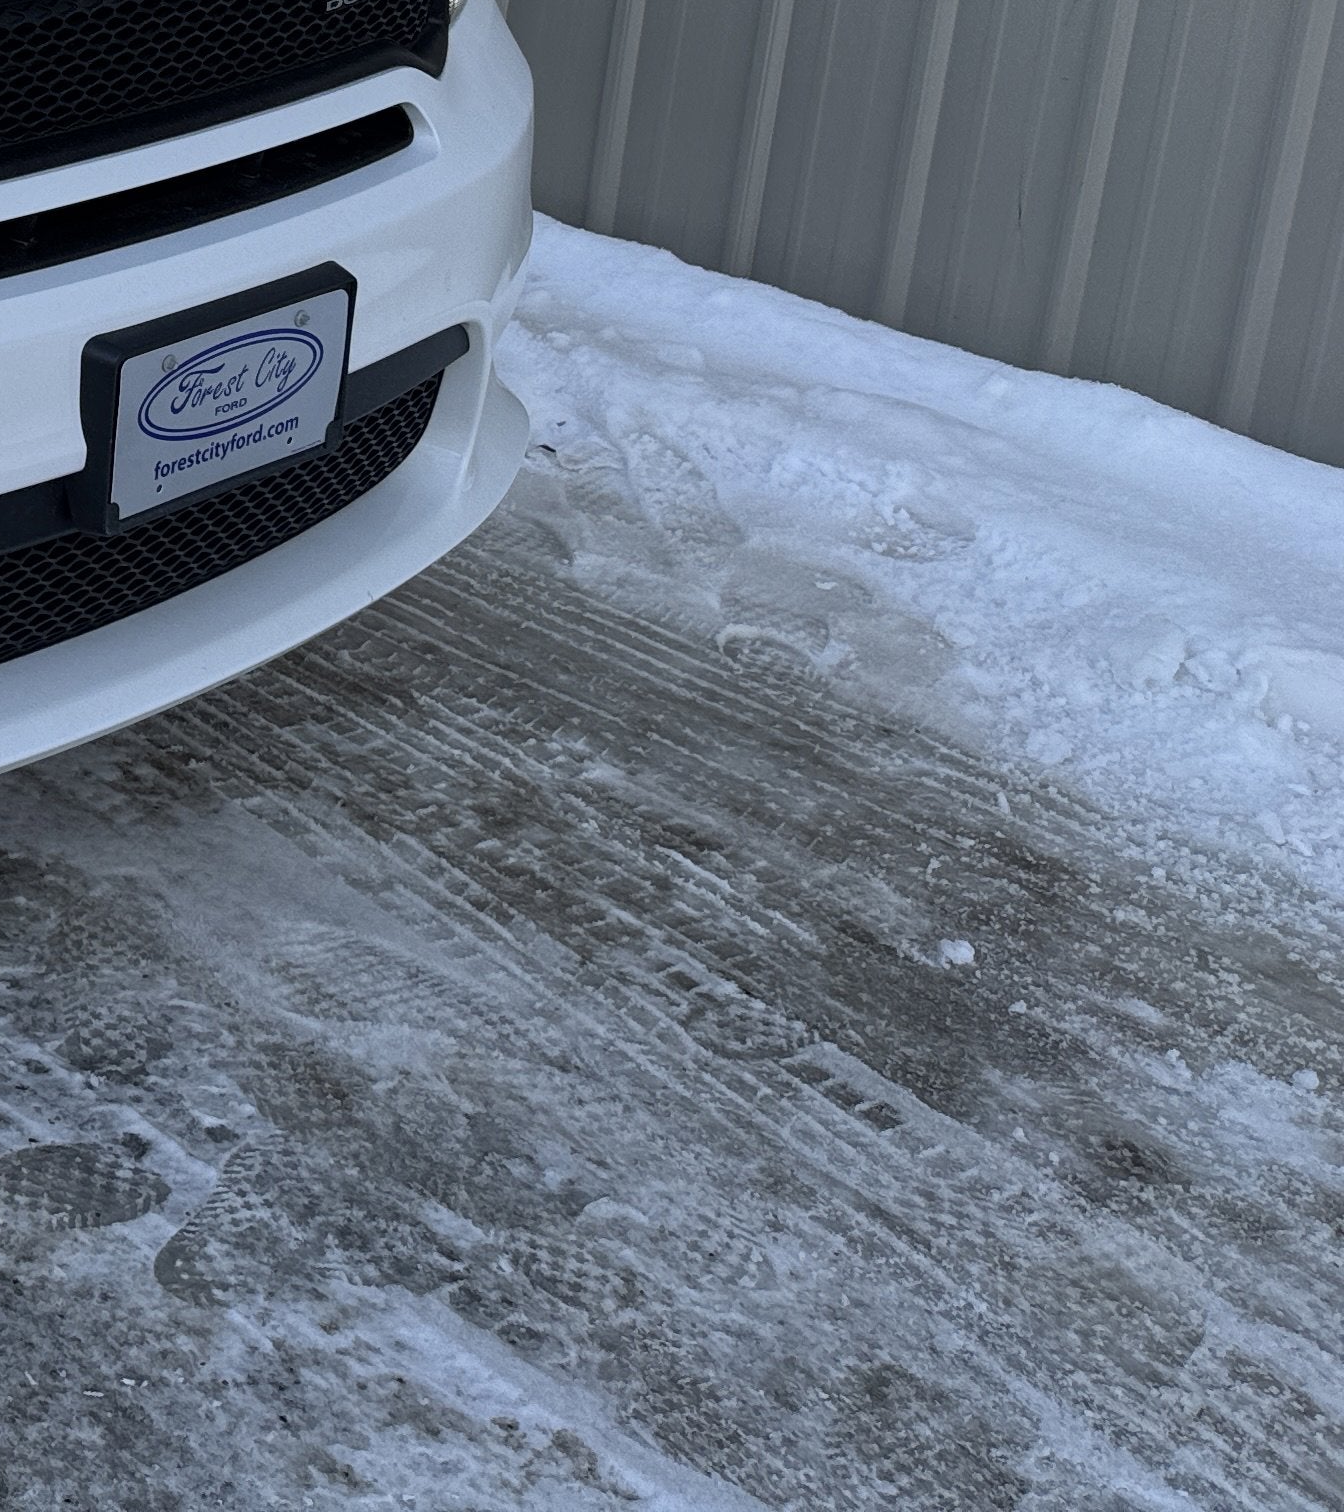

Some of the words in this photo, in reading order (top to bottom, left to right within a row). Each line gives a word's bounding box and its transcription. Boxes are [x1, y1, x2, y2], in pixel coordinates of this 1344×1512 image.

[170, 362, 249, 415] Forest
[254, 347, 296, 393] City
[214, 397, 248, 416] FORD
[153, 415, 300, 481] forestcityford.com
